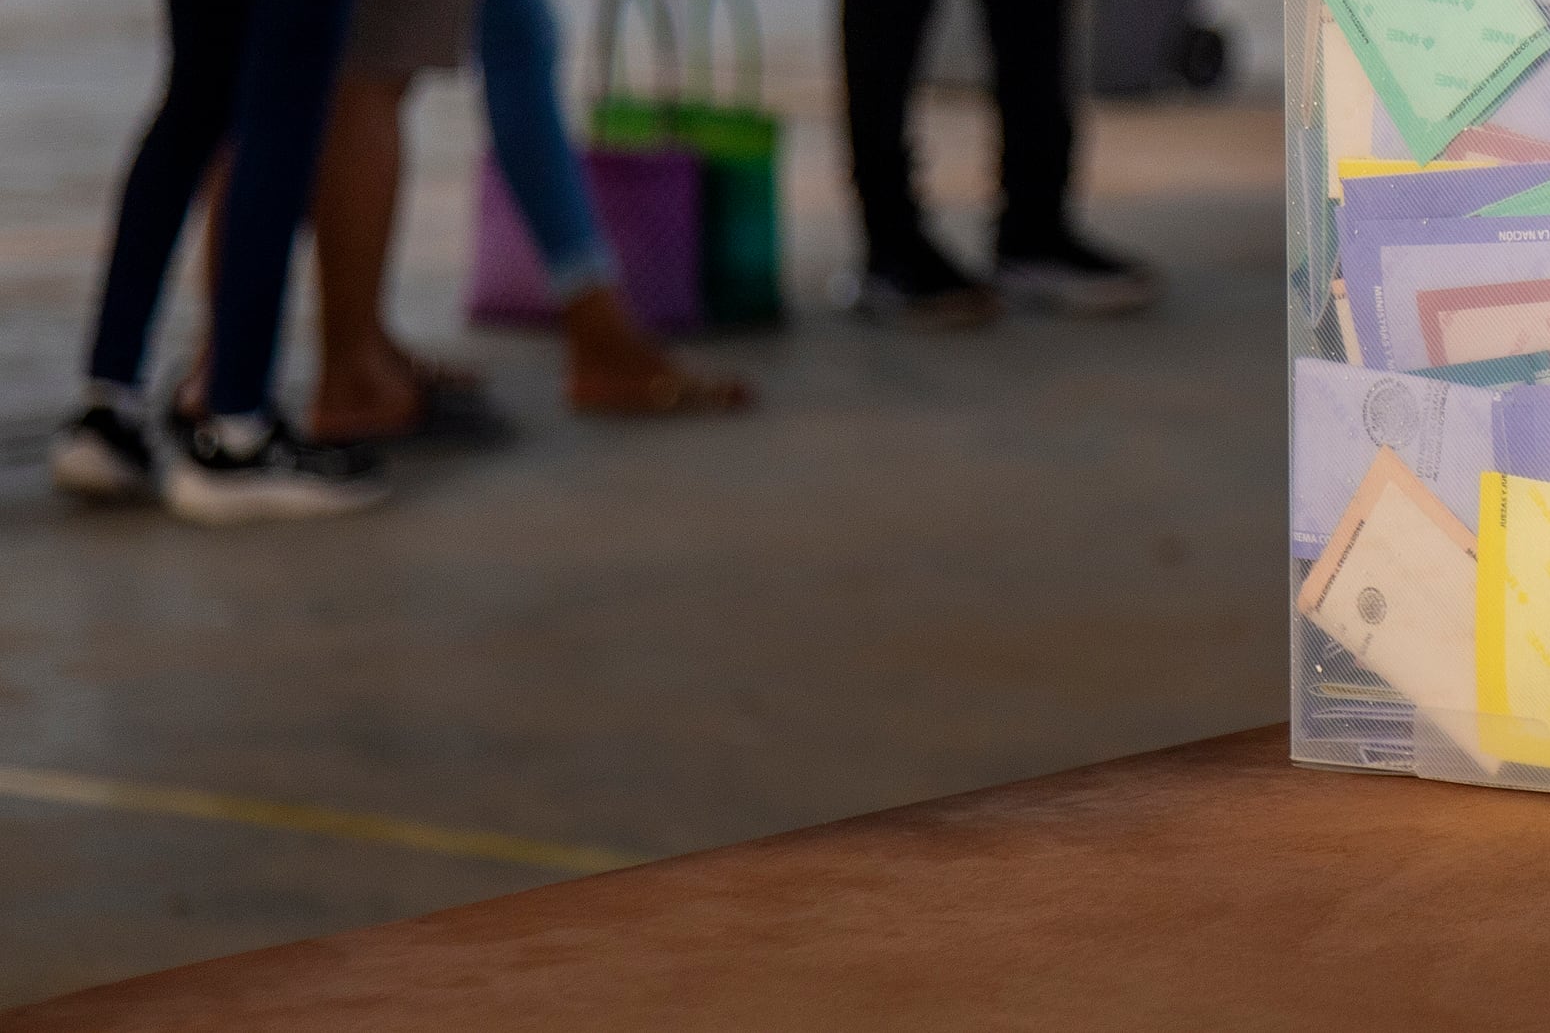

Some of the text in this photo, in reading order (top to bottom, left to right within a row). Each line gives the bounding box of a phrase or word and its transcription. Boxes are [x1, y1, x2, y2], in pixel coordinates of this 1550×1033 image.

[1497, 230, 1536, 242] NACIÓN
[1536, 229, 1549, 240] LA
[1312, 572, 1337, 613] MAGISTRA
